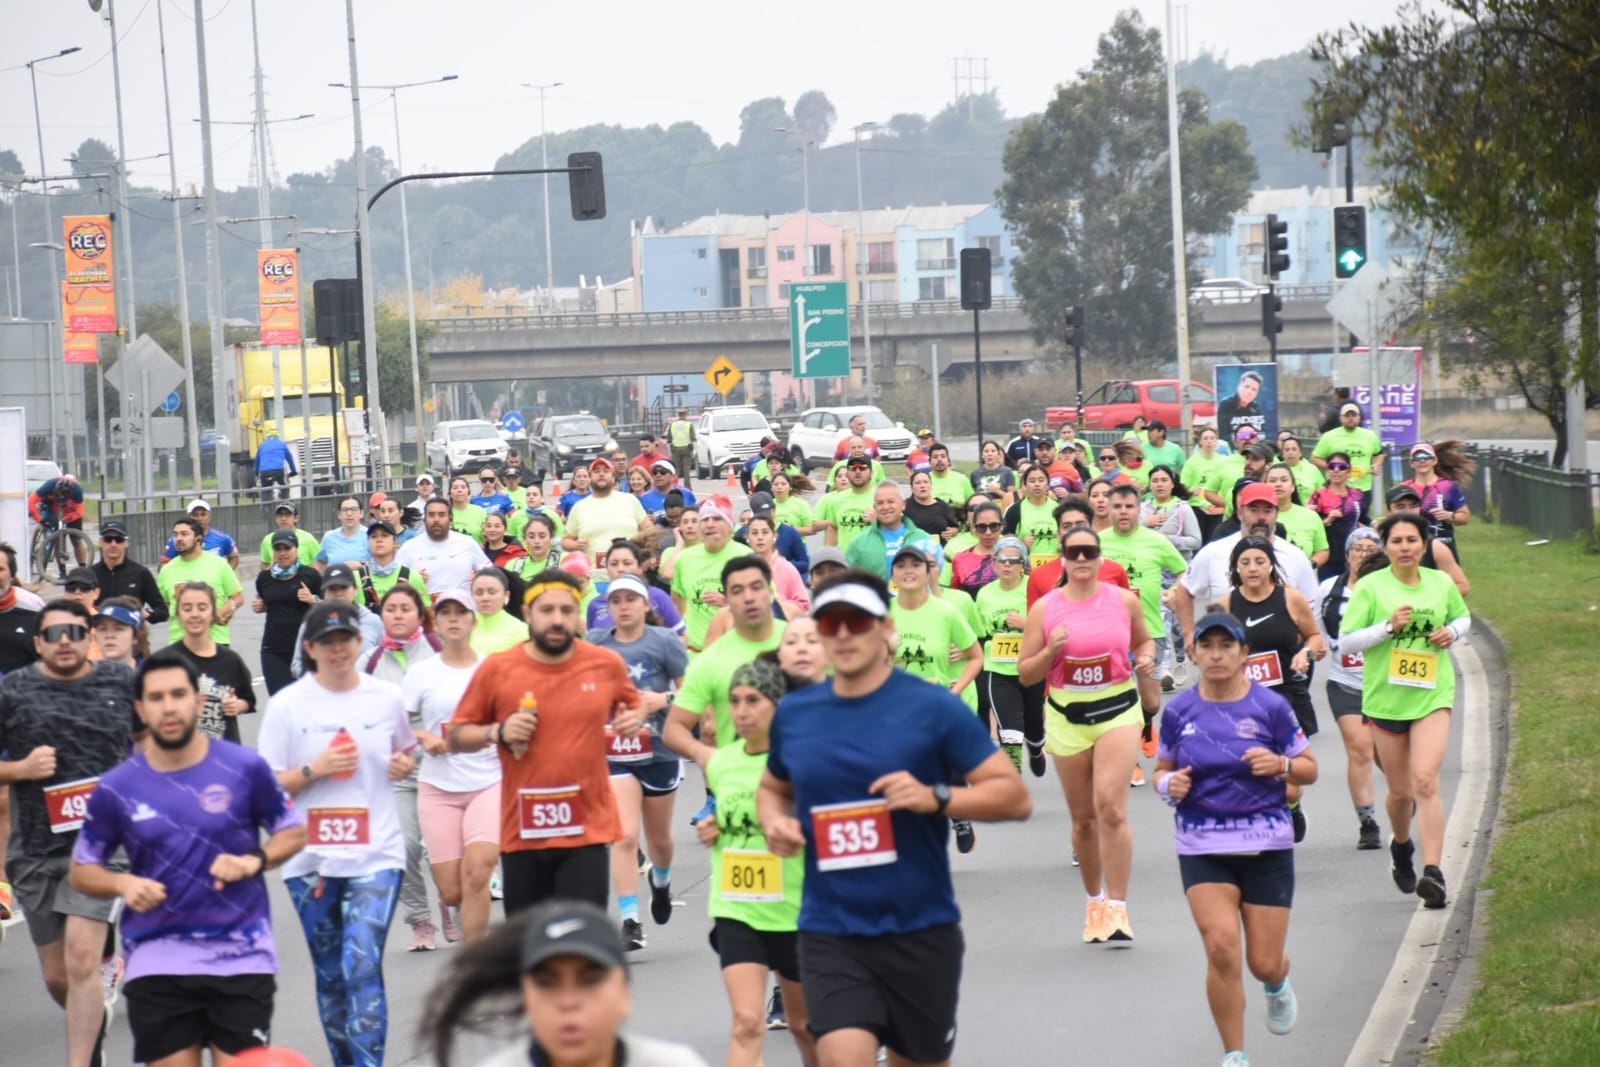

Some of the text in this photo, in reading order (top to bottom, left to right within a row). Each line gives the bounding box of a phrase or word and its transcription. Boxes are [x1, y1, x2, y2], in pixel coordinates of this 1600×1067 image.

[70, 234, 106, 248] REC
[264, 263, 293, 275] REC
[822, 308, 844, 316] PEDRO
[997, 642, 1019, 655] 774
[1072, 666, 1103, 684] 498
[1245, 662, 1271, 681] 481
[1398, 659, 1428, 678] 843
[611, 735, 642, 752] 444
[532, 802, 572, 826] 530
[318, 818, 358, 842] 532
[828, 818, 879, 855] 535
[731, 865, 767, 889] 801
